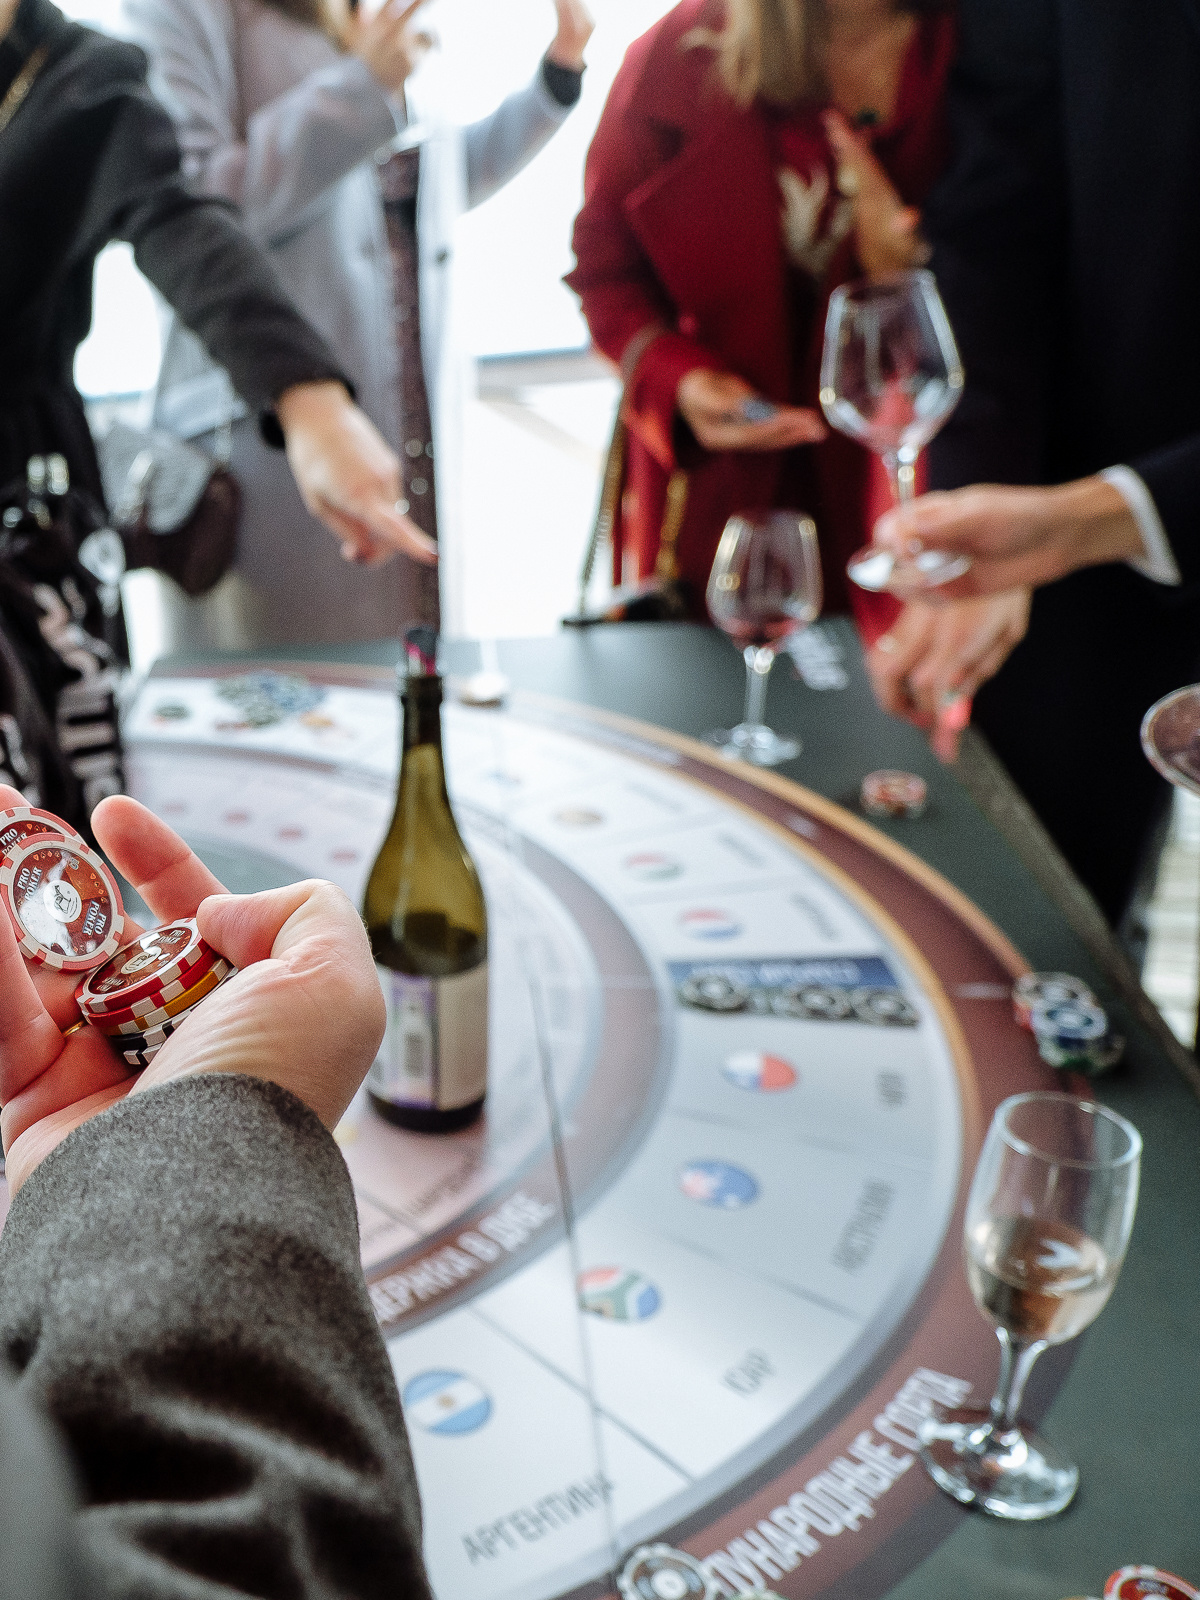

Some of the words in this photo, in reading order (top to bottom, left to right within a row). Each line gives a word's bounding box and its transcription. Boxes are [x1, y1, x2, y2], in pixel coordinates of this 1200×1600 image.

[0, 828, 18, 846] PRO
[17, 867, 31, 890] PRO
[24, 866, 43, 901] POKER
[83, 900, 100, 936] POKER
[94, 912, 107, 935] PRO
[368, 1246, 481, 1324] ЕРЖКА
